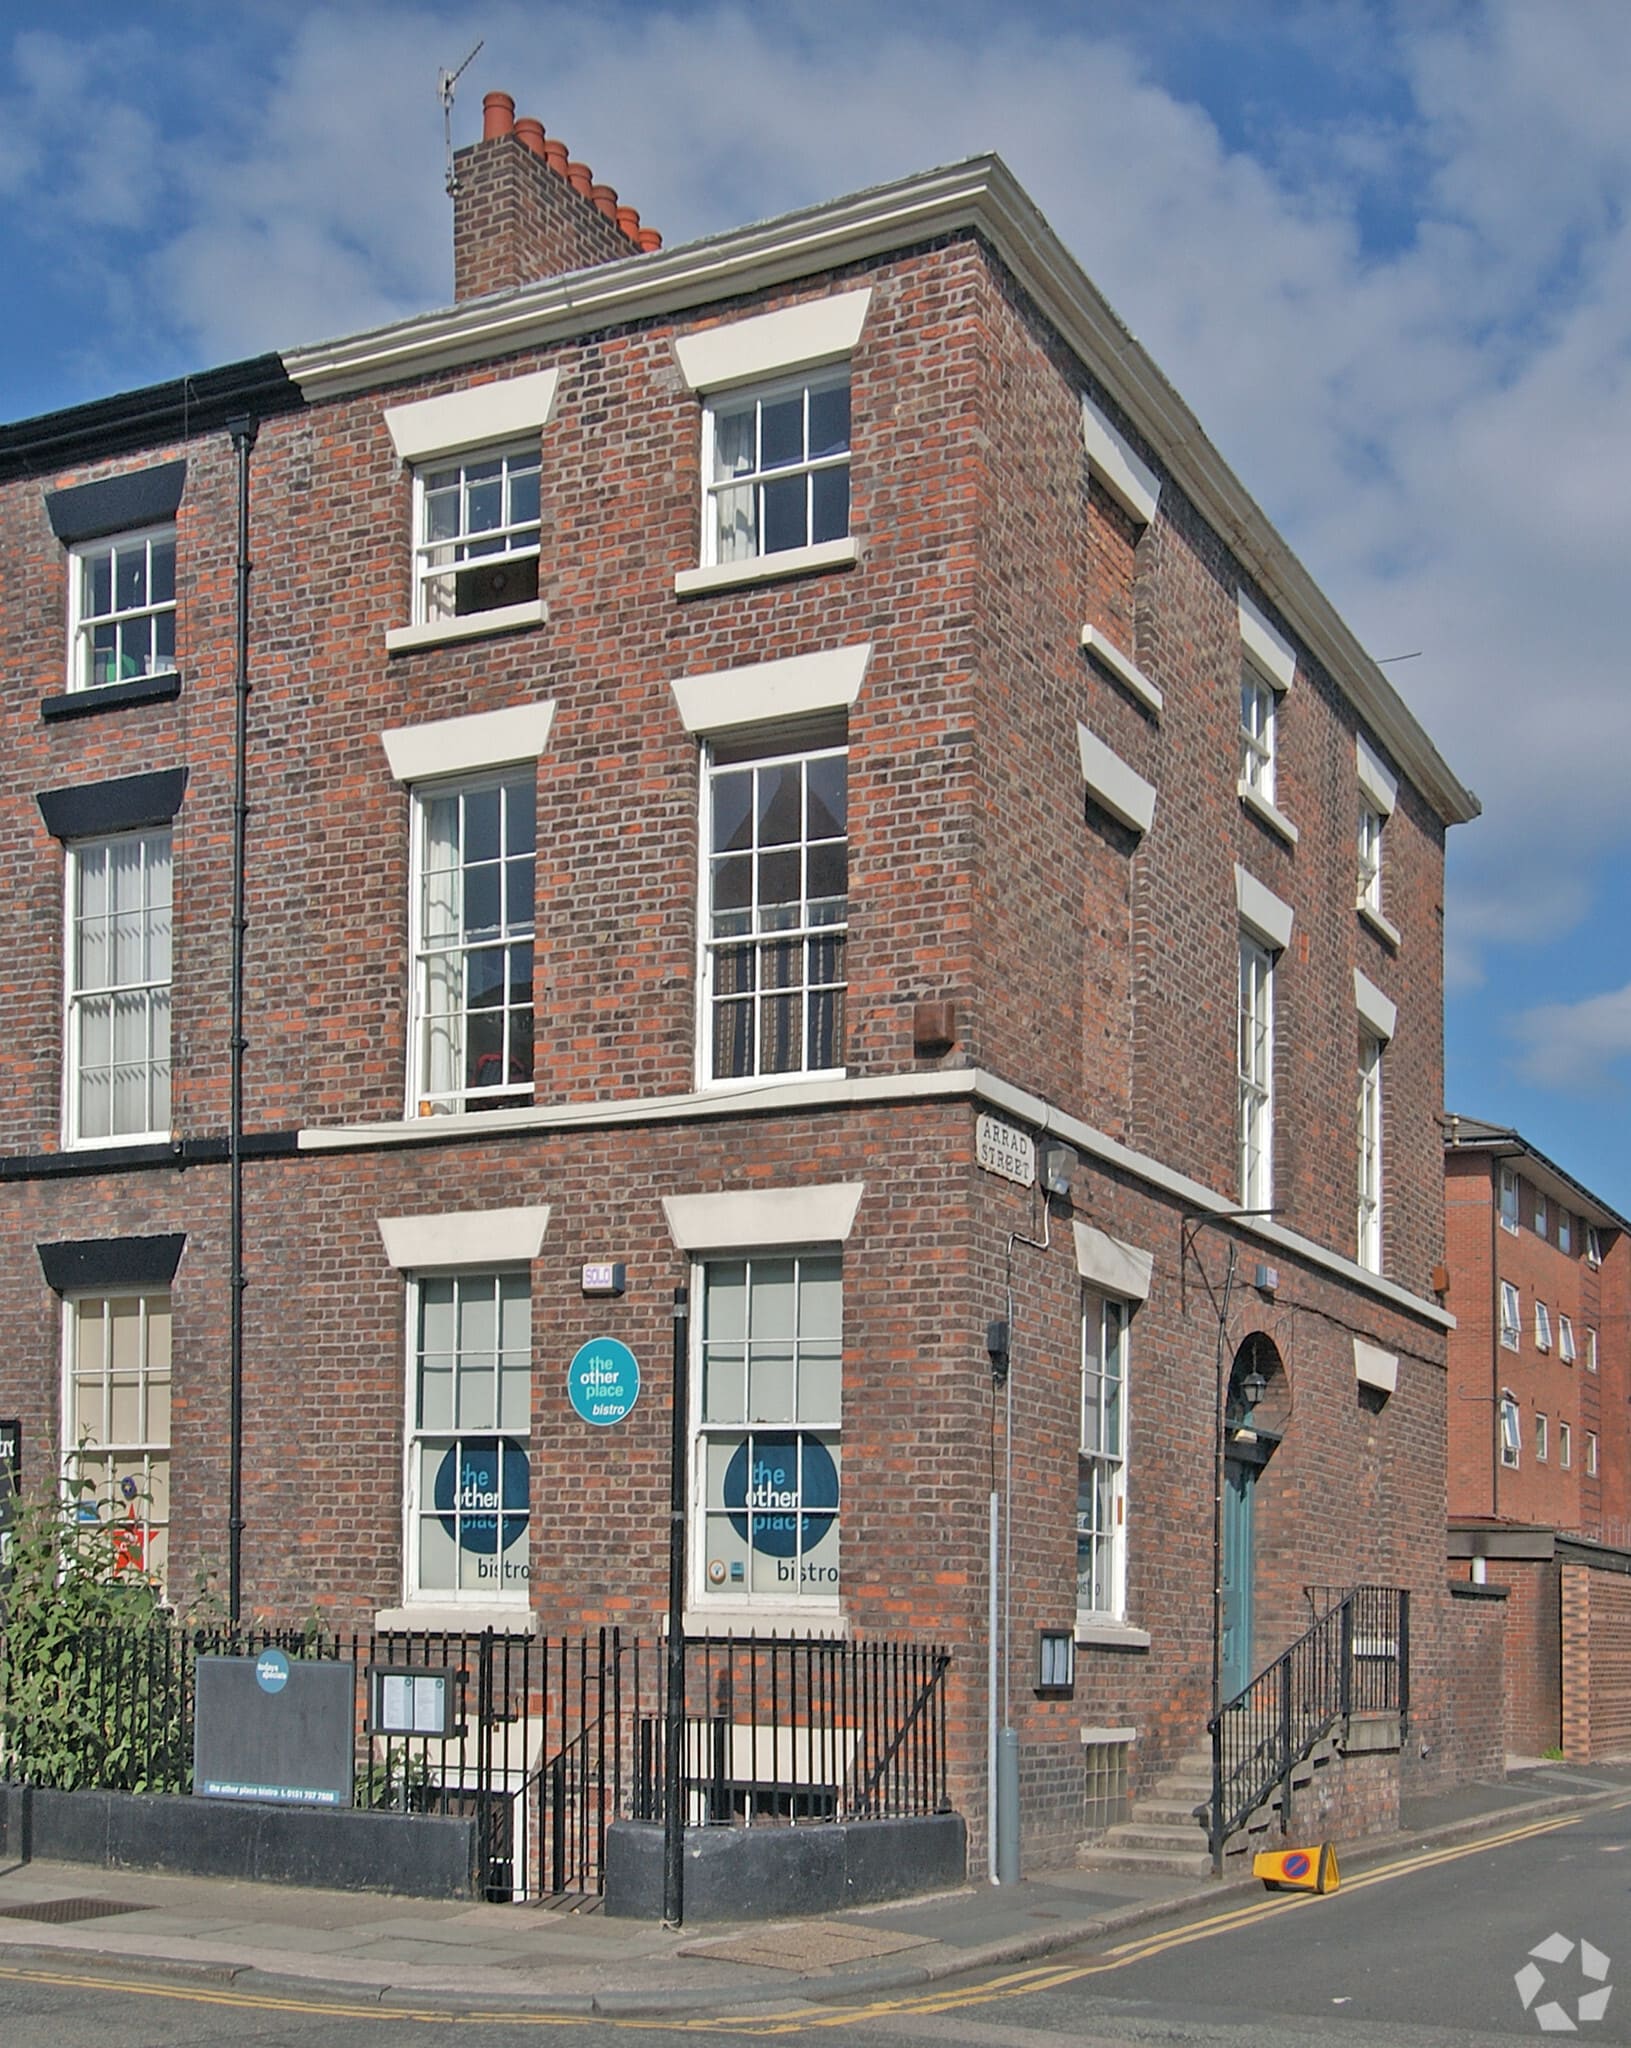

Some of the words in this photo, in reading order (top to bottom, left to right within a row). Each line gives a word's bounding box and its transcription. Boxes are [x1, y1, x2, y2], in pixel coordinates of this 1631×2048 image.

[983, 1121, 1028, 1155] ARRAD
[981, 1144, 1030, 1180] STREET
[589, 1356, 613, 1370] the
[580, 1367, 619, 1384] other
[586, 1385, 624, 1400] place
[592, 1403, 625, 1416] bistro
[777, 1559, 839, 1582] bistro
